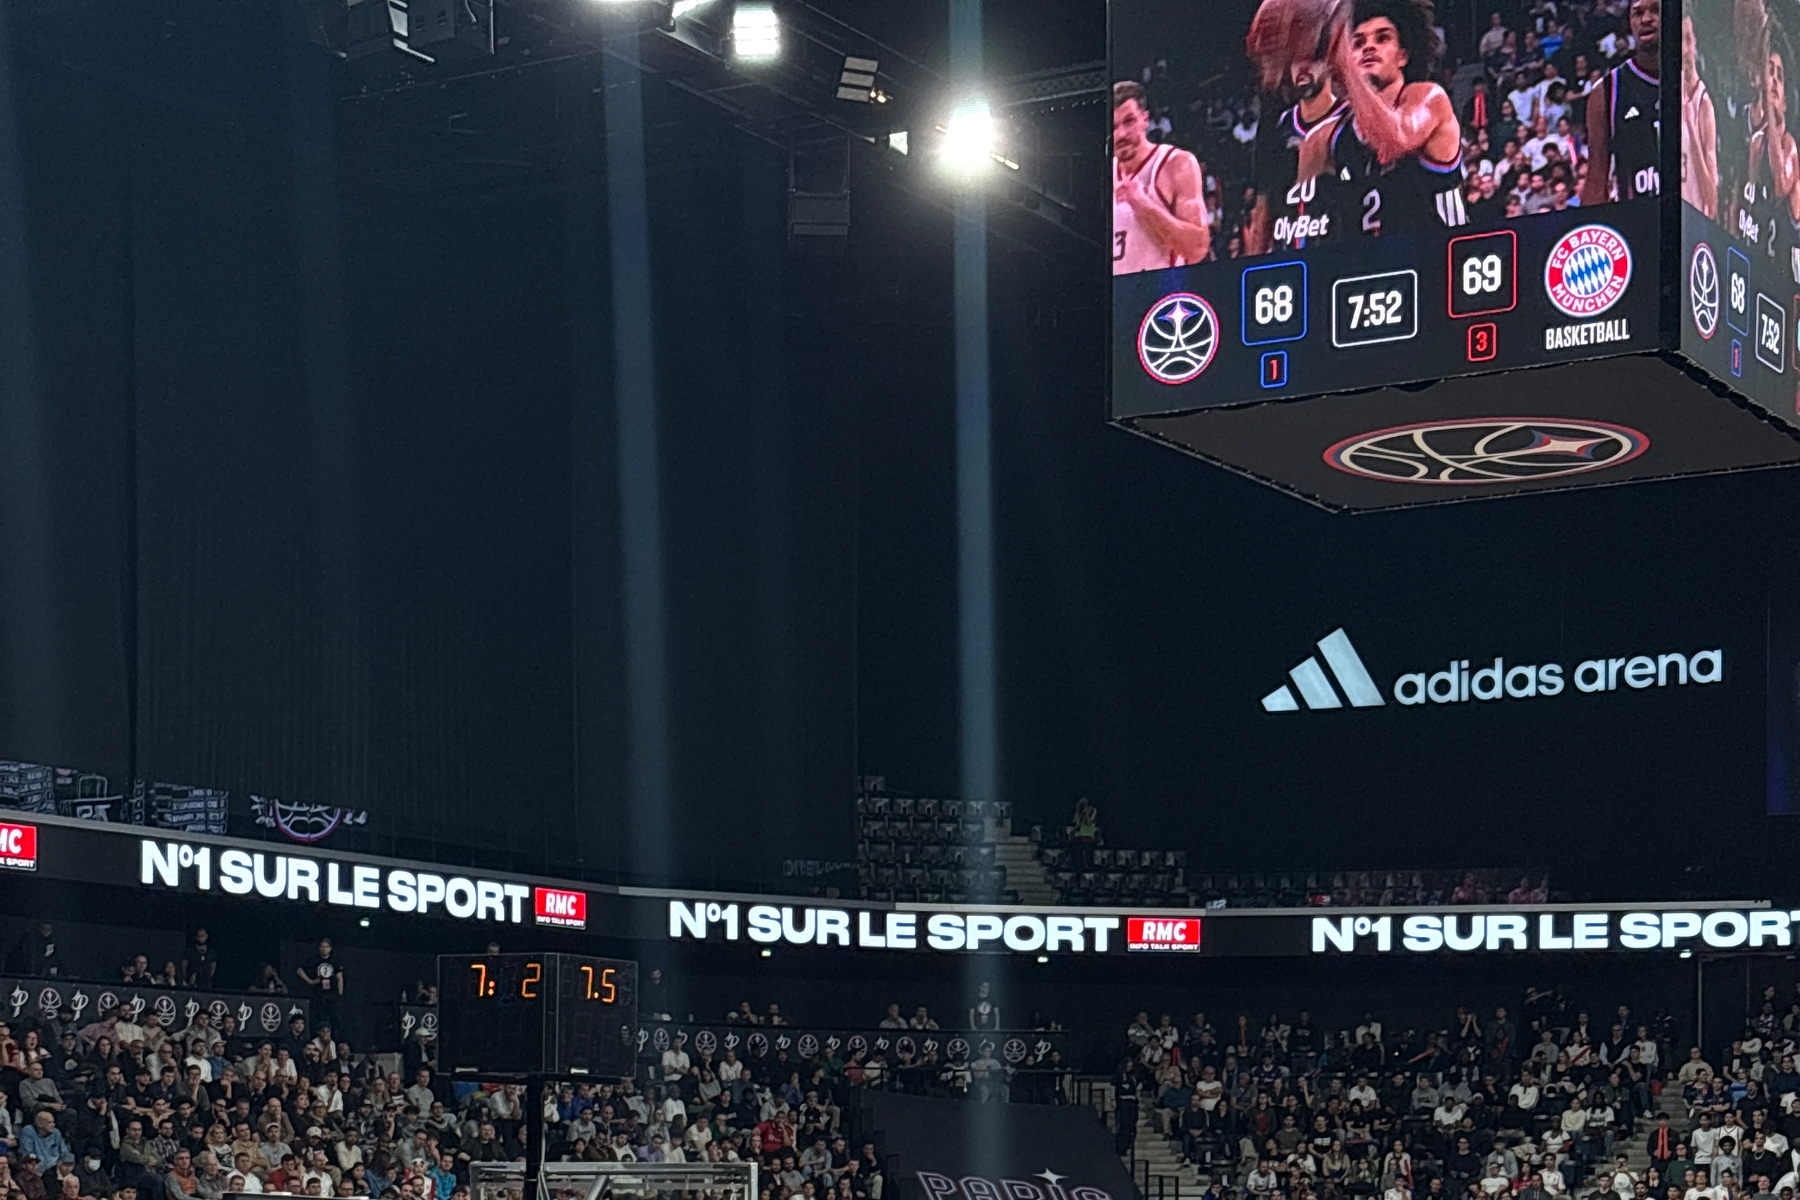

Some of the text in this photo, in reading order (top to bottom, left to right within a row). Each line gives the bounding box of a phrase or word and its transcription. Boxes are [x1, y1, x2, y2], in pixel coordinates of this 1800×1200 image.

[1635, 166, 1660, 195] Oly
[1362, 188, 1381, 231] 2
[1273, 214, 1330, 244] OlyBet
[1551, 229, 1626, 270] FC BAYERN
[1463, 254, 1502, 295] 69
[1552, 274, 1625, 312] MÜNCHEN
[1730, 272, 1745, 314] 68
[1255, 285, 1293, 325] 68
[1348, 290, 1402, 329] 7:52
[1475, 331, 1489, 352] 3
[1545, 318, 1630, 350] BASKETBALL
[1761, 314, 1780, 354] 7:52
[1270, 359, 1278, 381] 1
[1394, 650, 1722, 705] adidas arena
[0, 828, 22, 854] MC
[220, 850, 320, 901] SUR
[329, 863, 380, 907] LE
[388, 871, 530, 922] SPORT
[545, 892, 577, 916] RMC
[748, 906, 850, 945] SUR
[860, 912, 917, 948] LE
[928, 915, 1119, 951] SPORT
[1142, 921, 1187, 941] RMC
[1403, 915, 1527, 951] SUR
[1540, 914, 1609, 949] LE
[521, 963, 541, 998] 2
[580, 966, 616, 1003] 7.5
